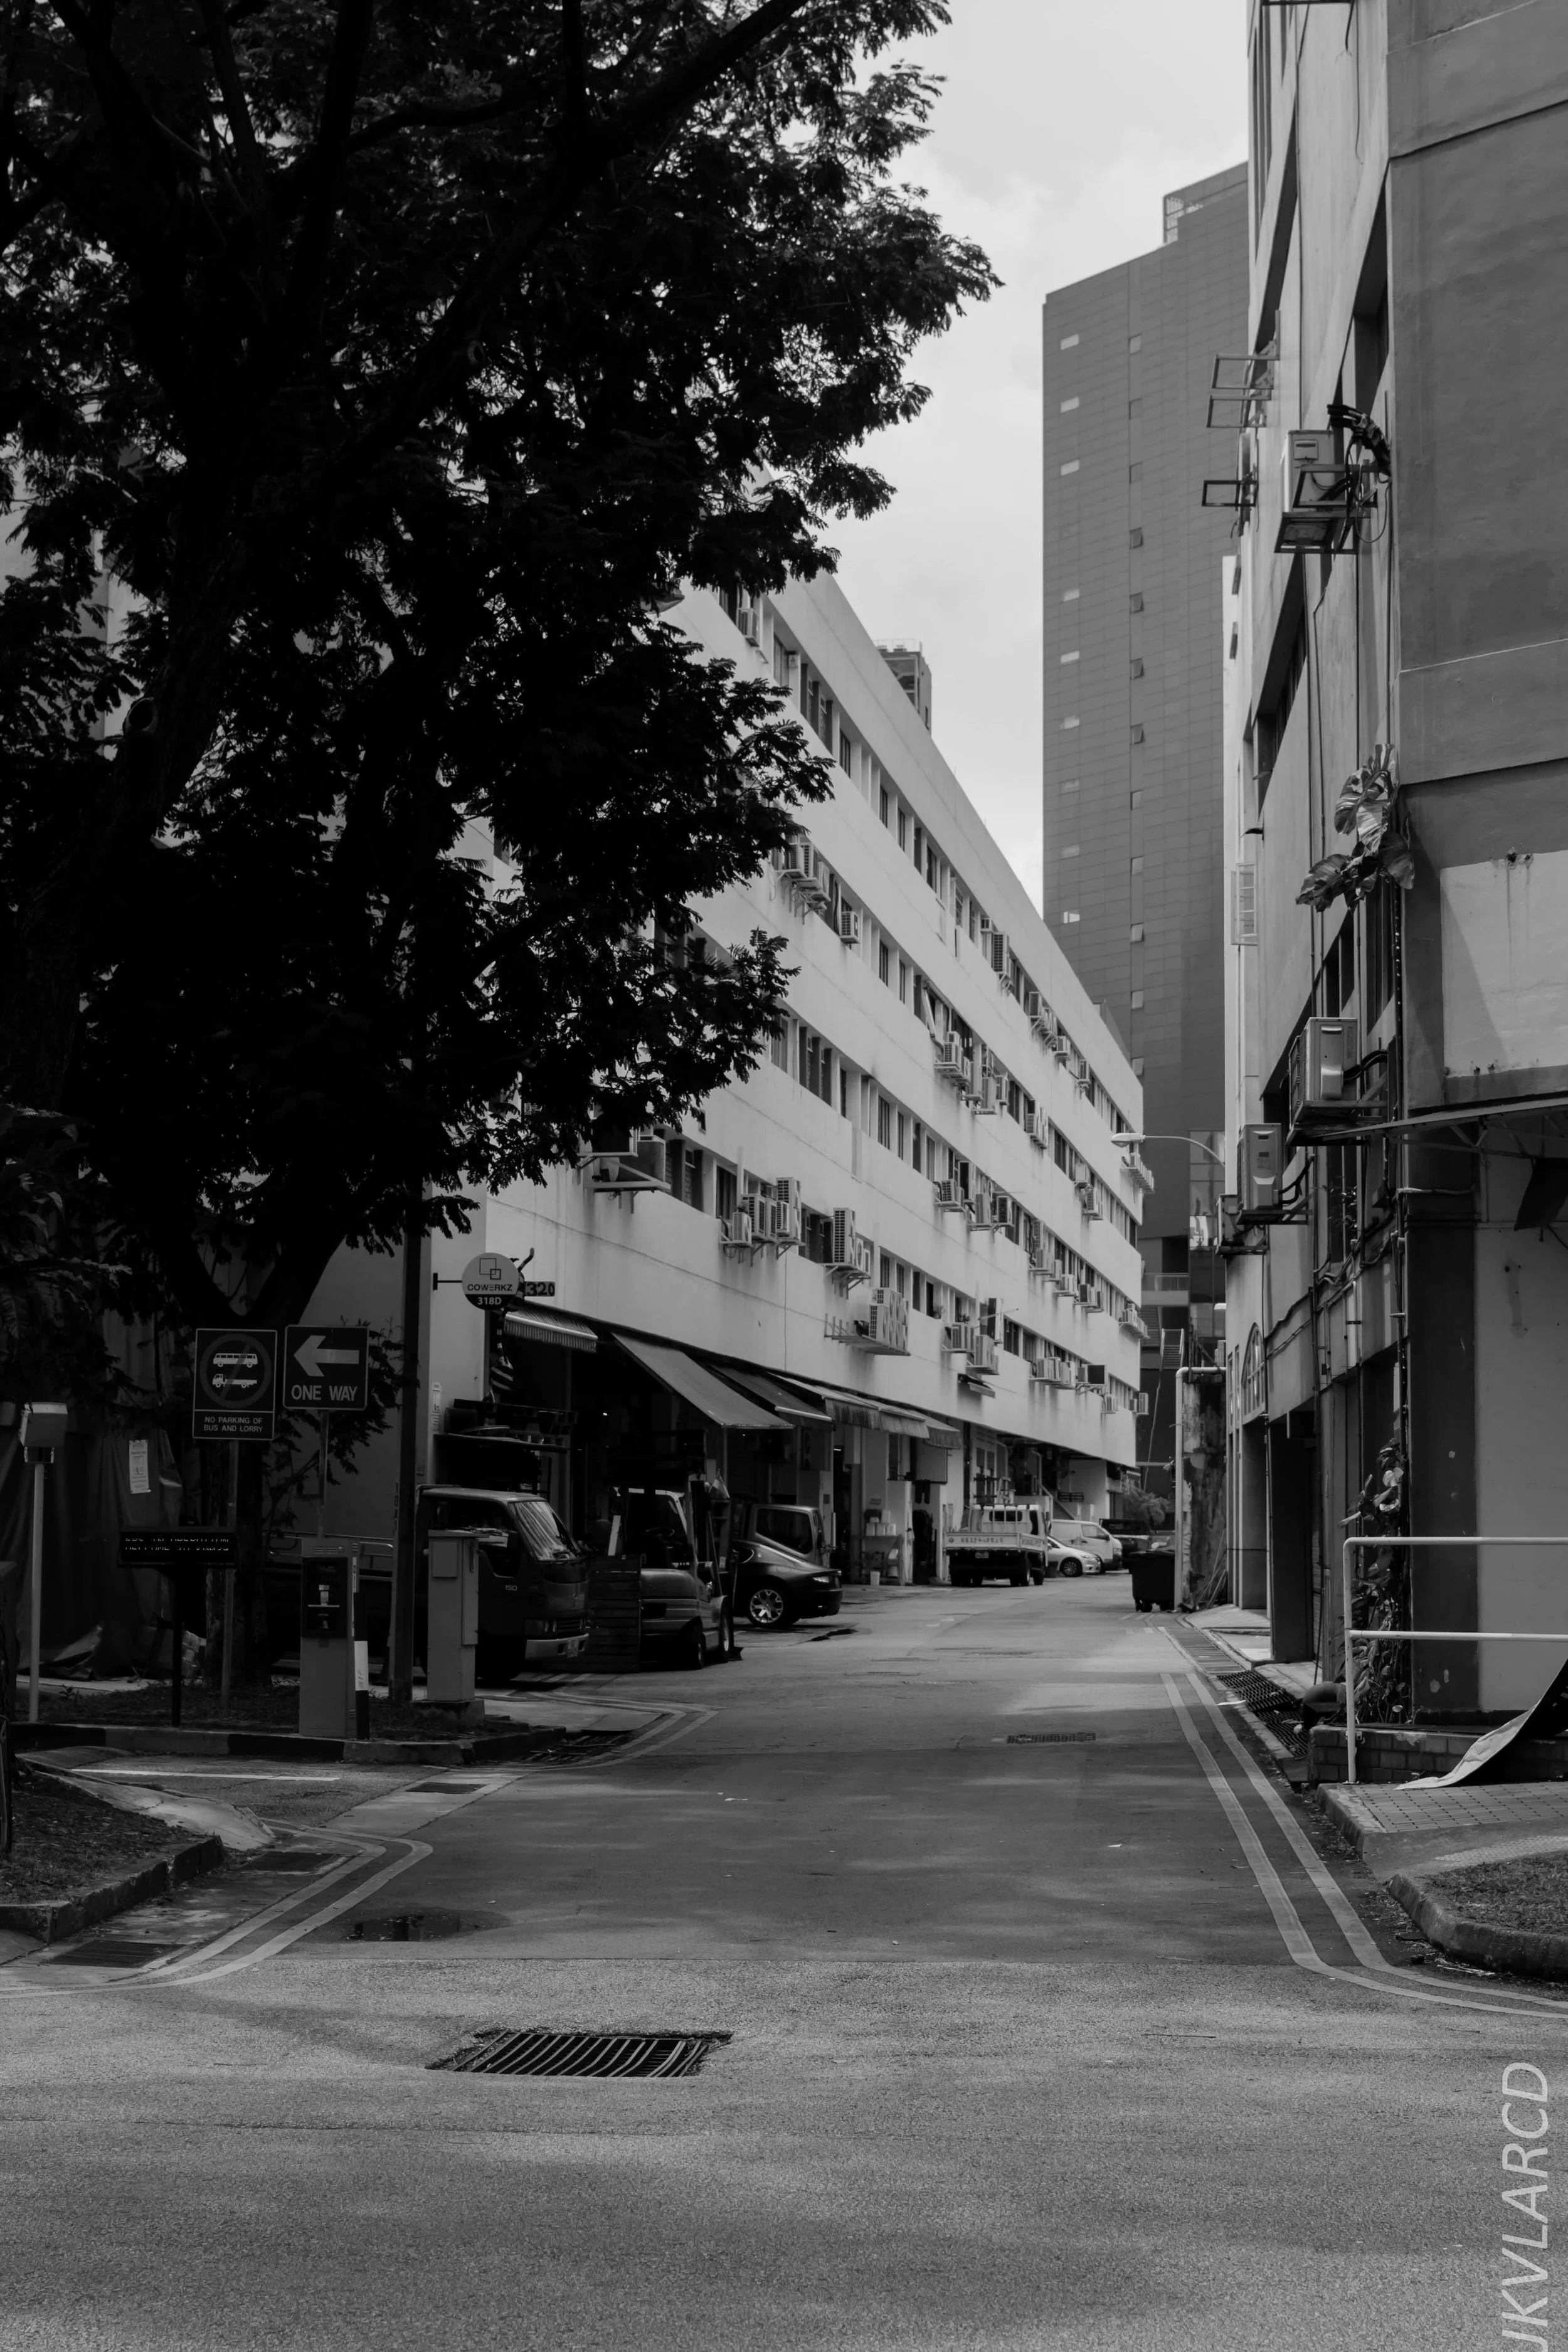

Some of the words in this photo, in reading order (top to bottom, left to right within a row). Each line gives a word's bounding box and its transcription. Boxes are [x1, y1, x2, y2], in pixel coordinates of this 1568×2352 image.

[527, 1282, 555, 1296] 320
[477, 1296, 502, 1305] 318D
[291, 1384, 322, 1401] ONE
[329, 1385, 358, 1401] WAY
